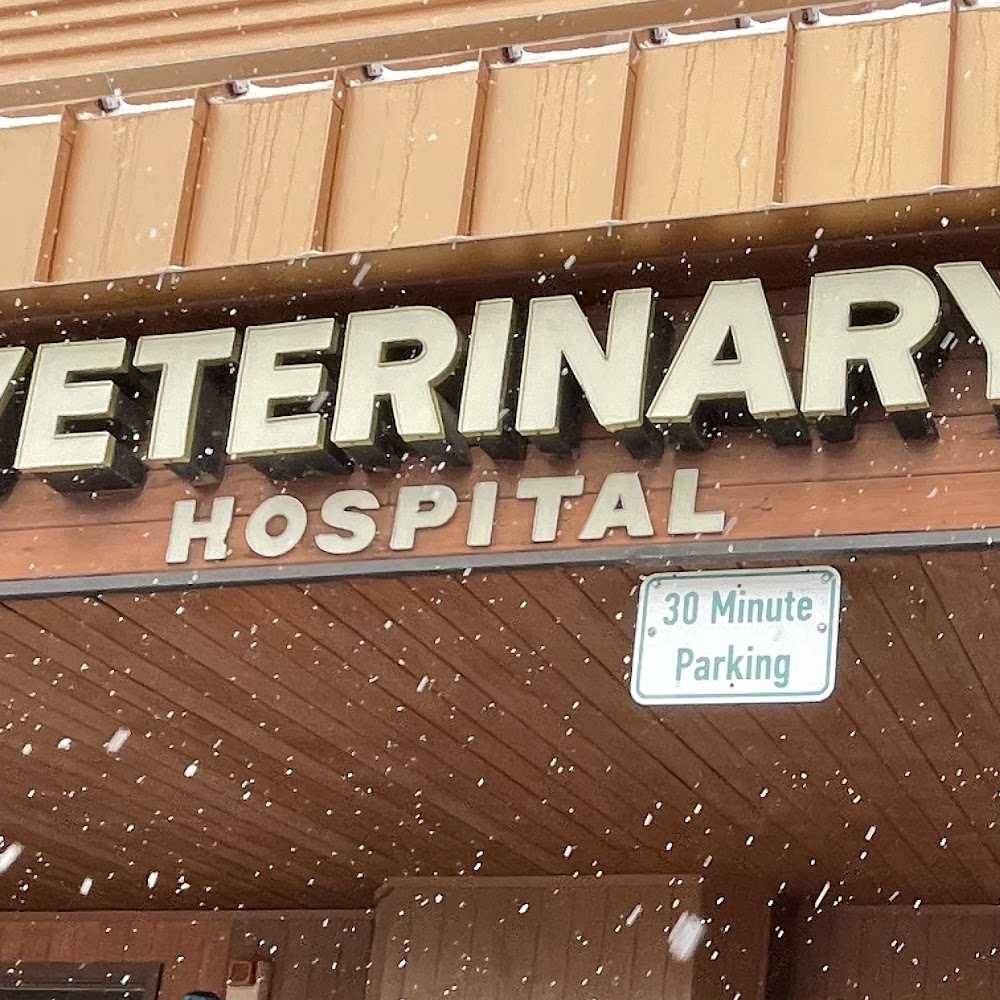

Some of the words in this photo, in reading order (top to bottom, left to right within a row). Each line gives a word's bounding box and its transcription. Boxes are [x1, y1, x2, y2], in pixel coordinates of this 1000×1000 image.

[165, 467, 727, 564] HOSPITAL
[662, 593, 699, 626] 30
[709, 588, 814, 626] Minute
[675, 646, 792, 689] Parking
